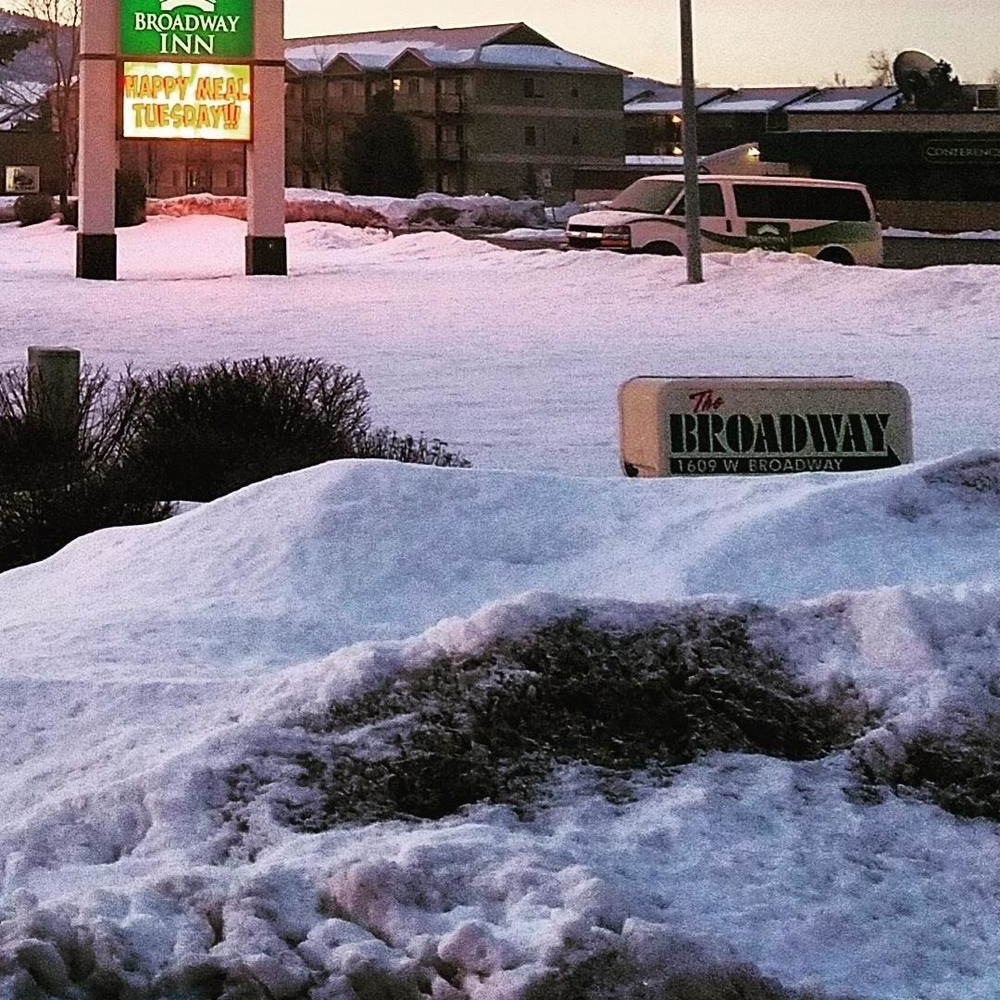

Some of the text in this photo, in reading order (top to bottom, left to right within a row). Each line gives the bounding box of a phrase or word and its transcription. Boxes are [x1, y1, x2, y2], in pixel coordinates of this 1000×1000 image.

[134, 11, 240, 33] BROADWAY
[159, 33, 216, 55] INN
[124, 75, 249, 101] HAPPY MEAL
[689, 388, 725, 412] The
[669, 413, 891, 454] BROADWAY
[677, 458, 843, 473] 1609 W BROADWAY
